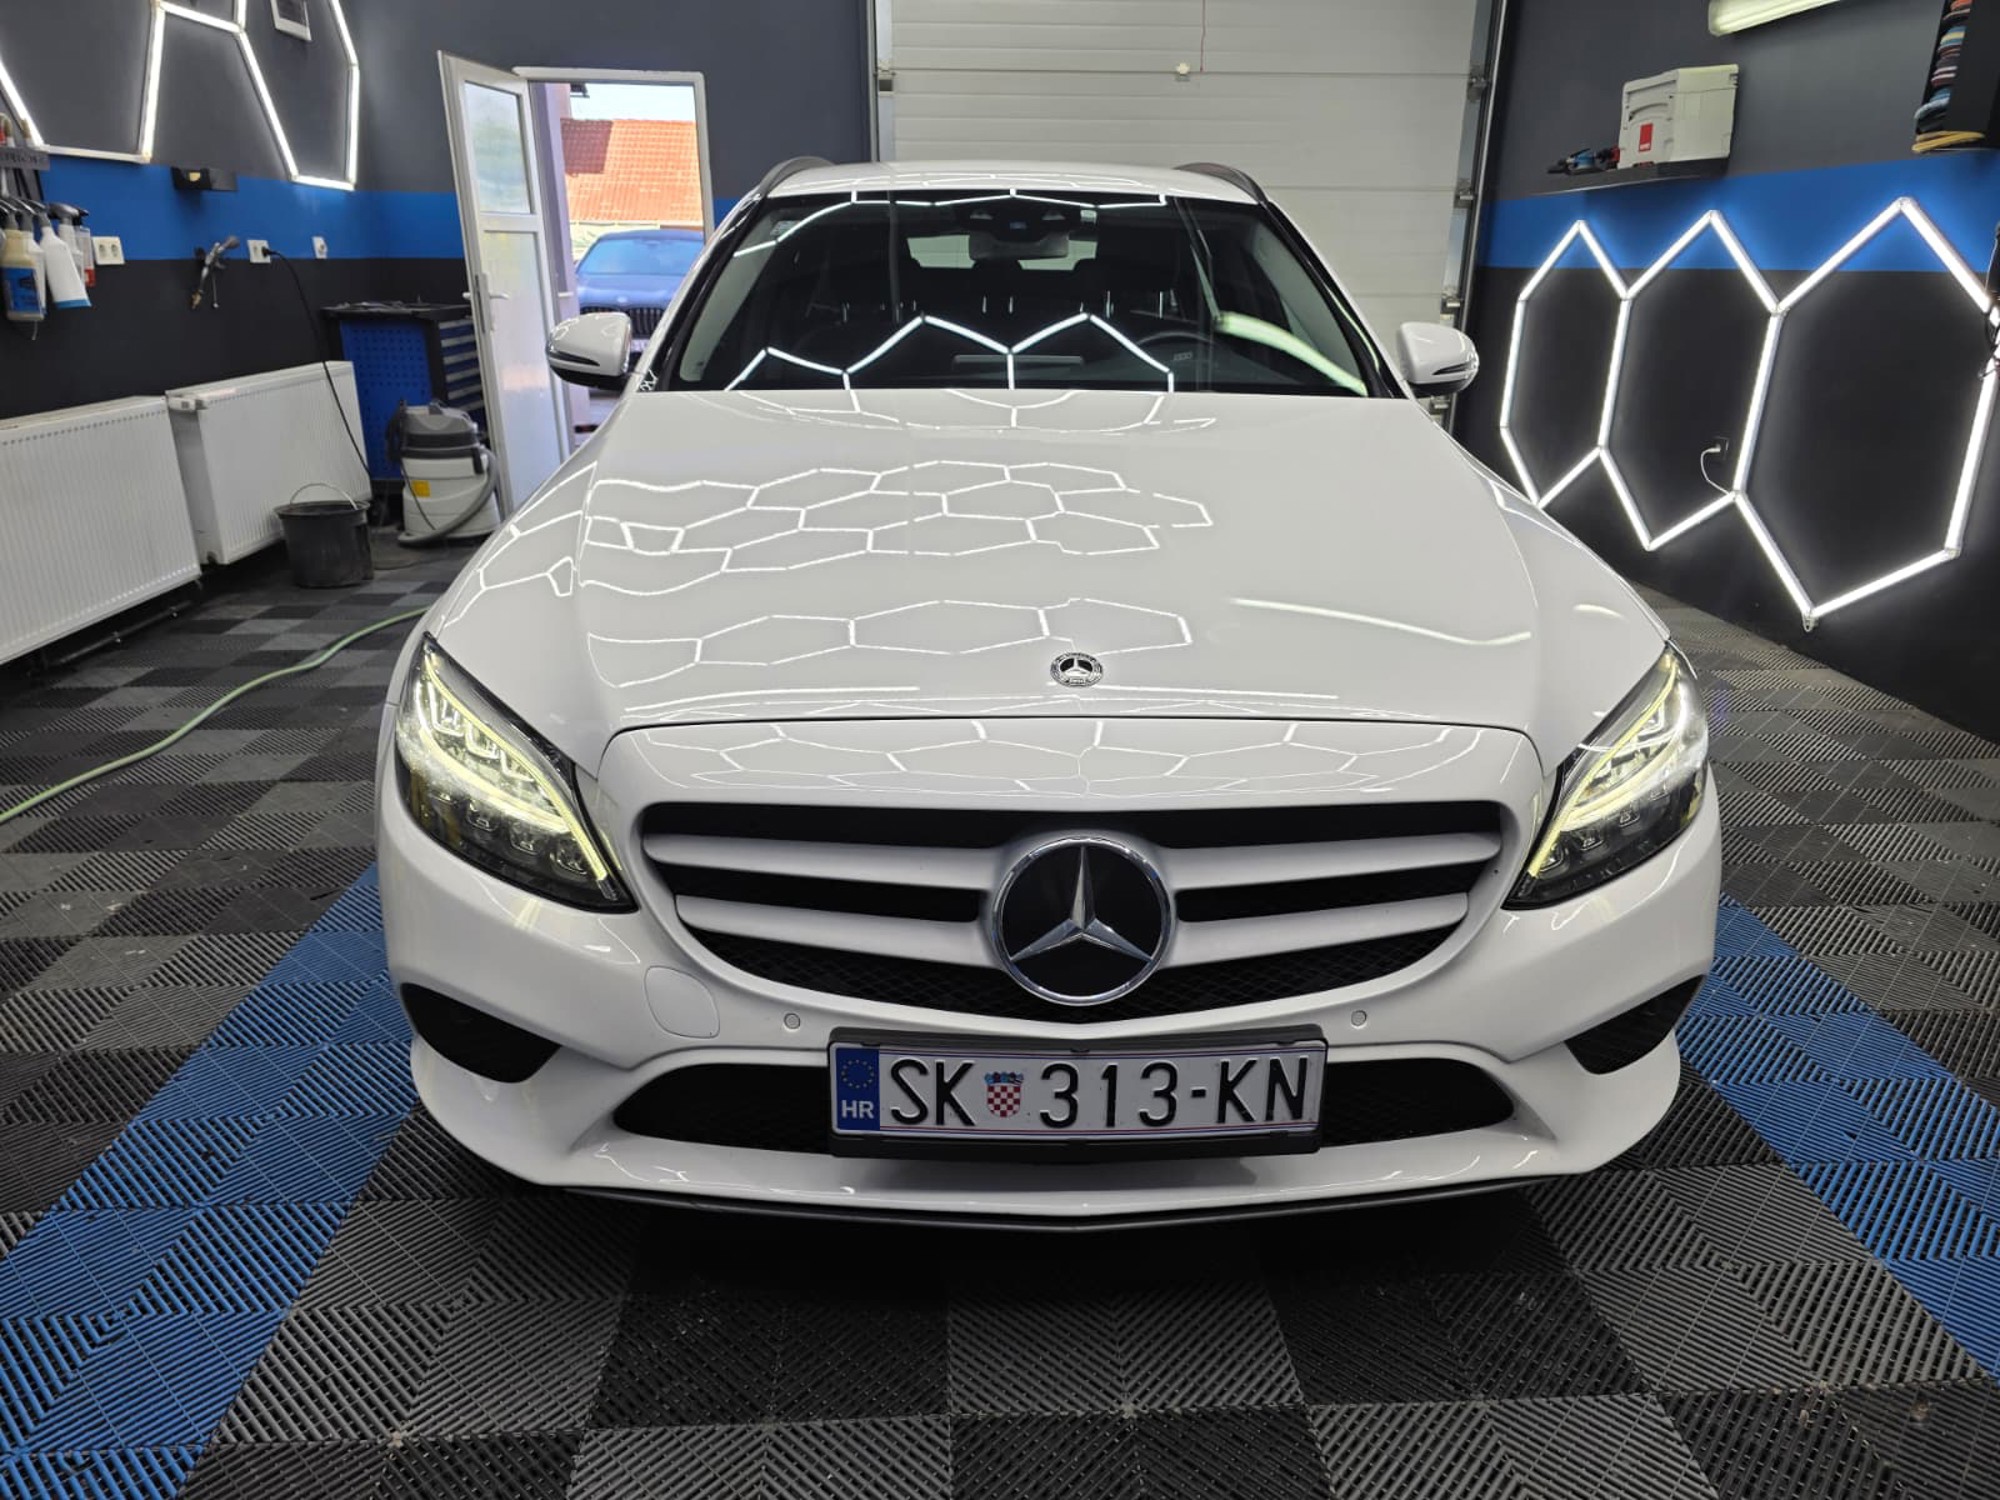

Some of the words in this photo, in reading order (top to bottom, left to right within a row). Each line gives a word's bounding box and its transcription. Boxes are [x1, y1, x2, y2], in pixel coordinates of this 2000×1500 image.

[841, 1100, 874, 1119] HR
[890, 1057, 976, 1126] SK
[1039, 1056, 1308, 1128] 313-KN
